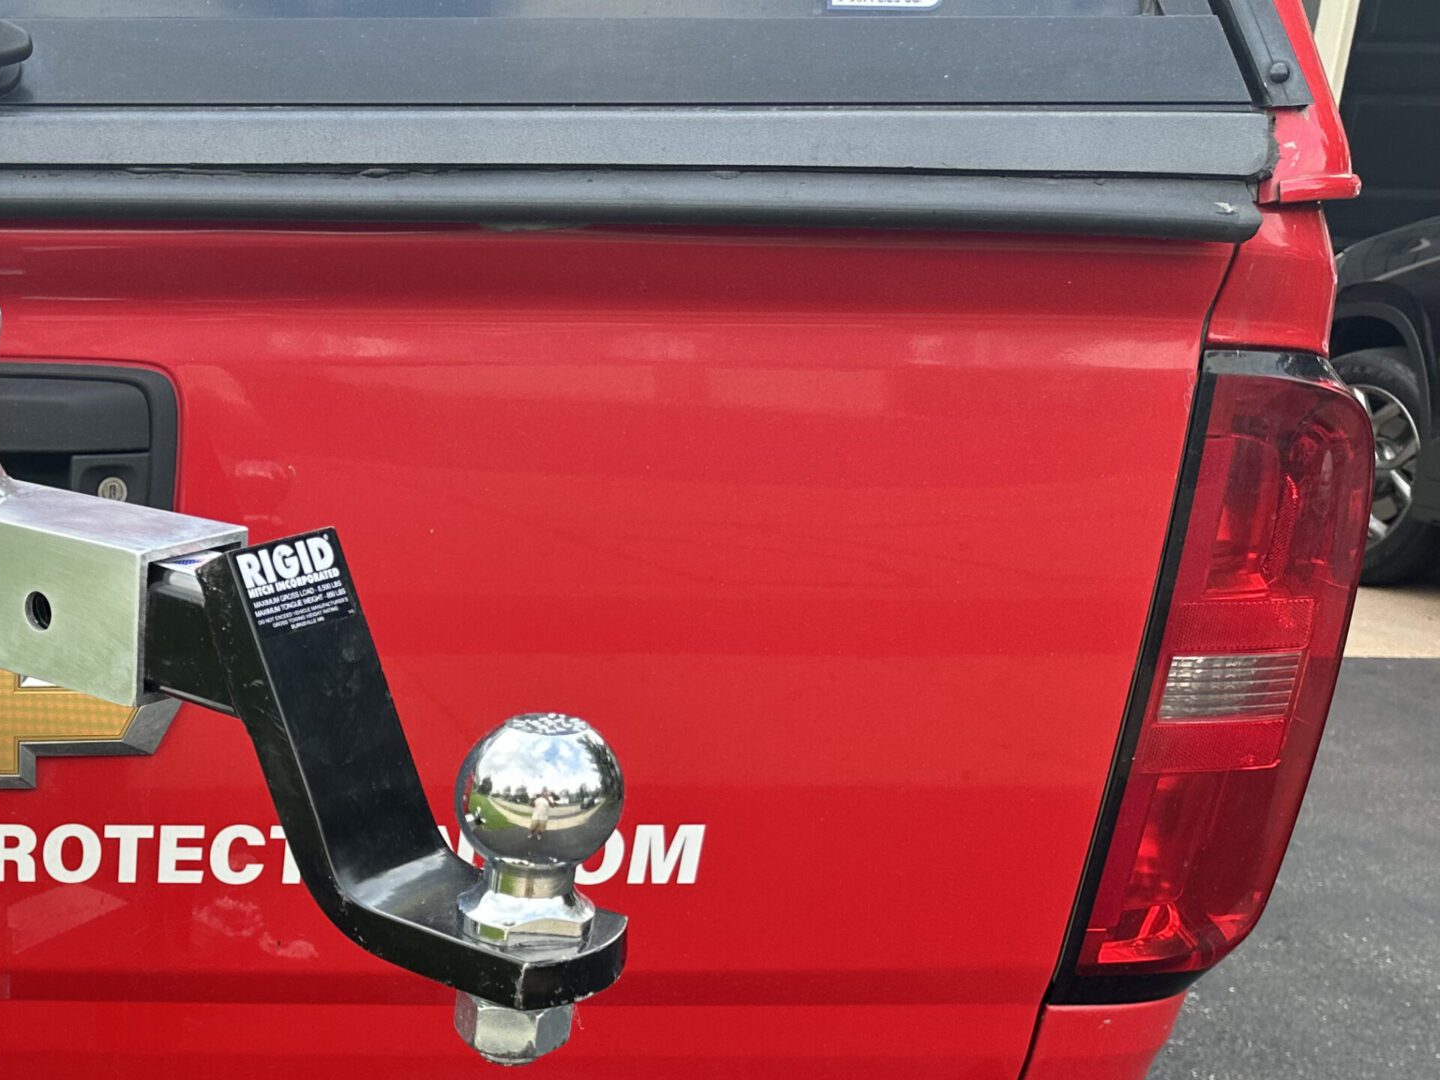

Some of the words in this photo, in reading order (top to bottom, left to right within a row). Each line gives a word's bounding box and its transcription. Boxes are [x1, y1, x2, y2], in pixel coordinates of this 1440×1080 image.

[236, 537, 334, 589] RIGID
[248, 584, 274, 598] HITCH
[276, 568, 339, 591] INCORPORATED
